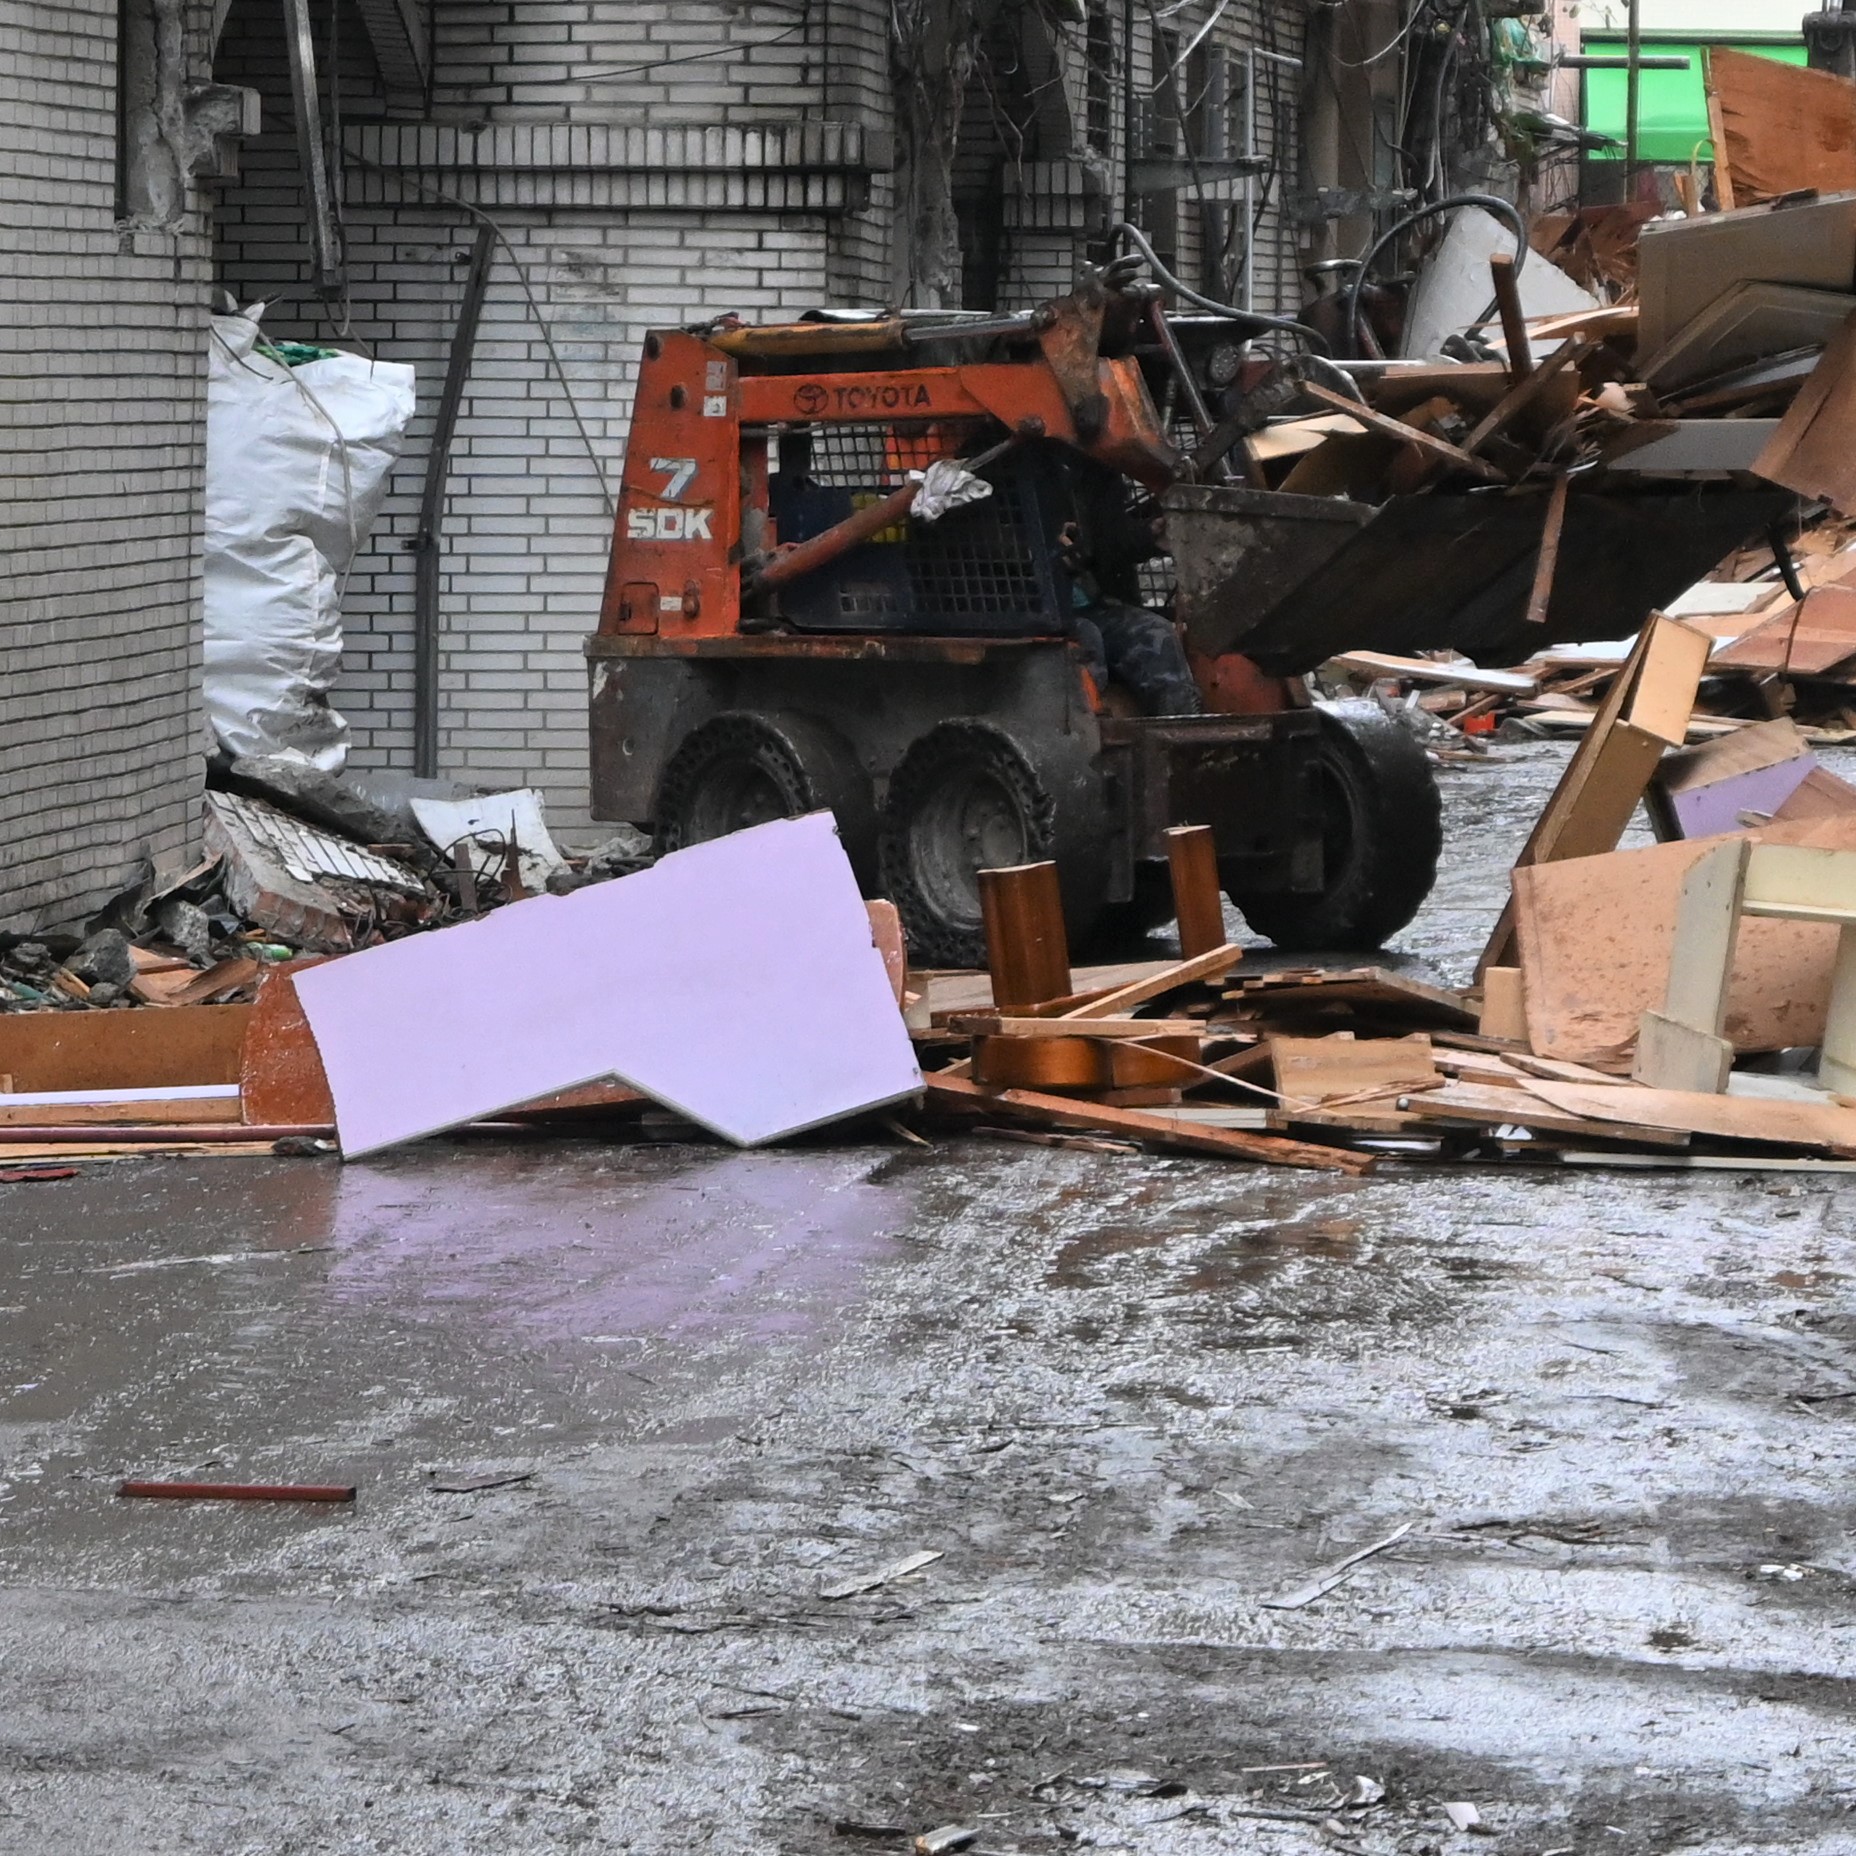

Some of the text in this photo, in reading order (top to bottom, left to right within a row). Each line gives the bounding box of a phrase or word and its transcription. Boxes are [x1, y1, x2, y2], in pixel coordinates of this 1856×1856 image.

[833, 384, 931, 408] TOYOTA
[649, 457, 697, 498] 7
[627, 508, 714, 540] SDK
